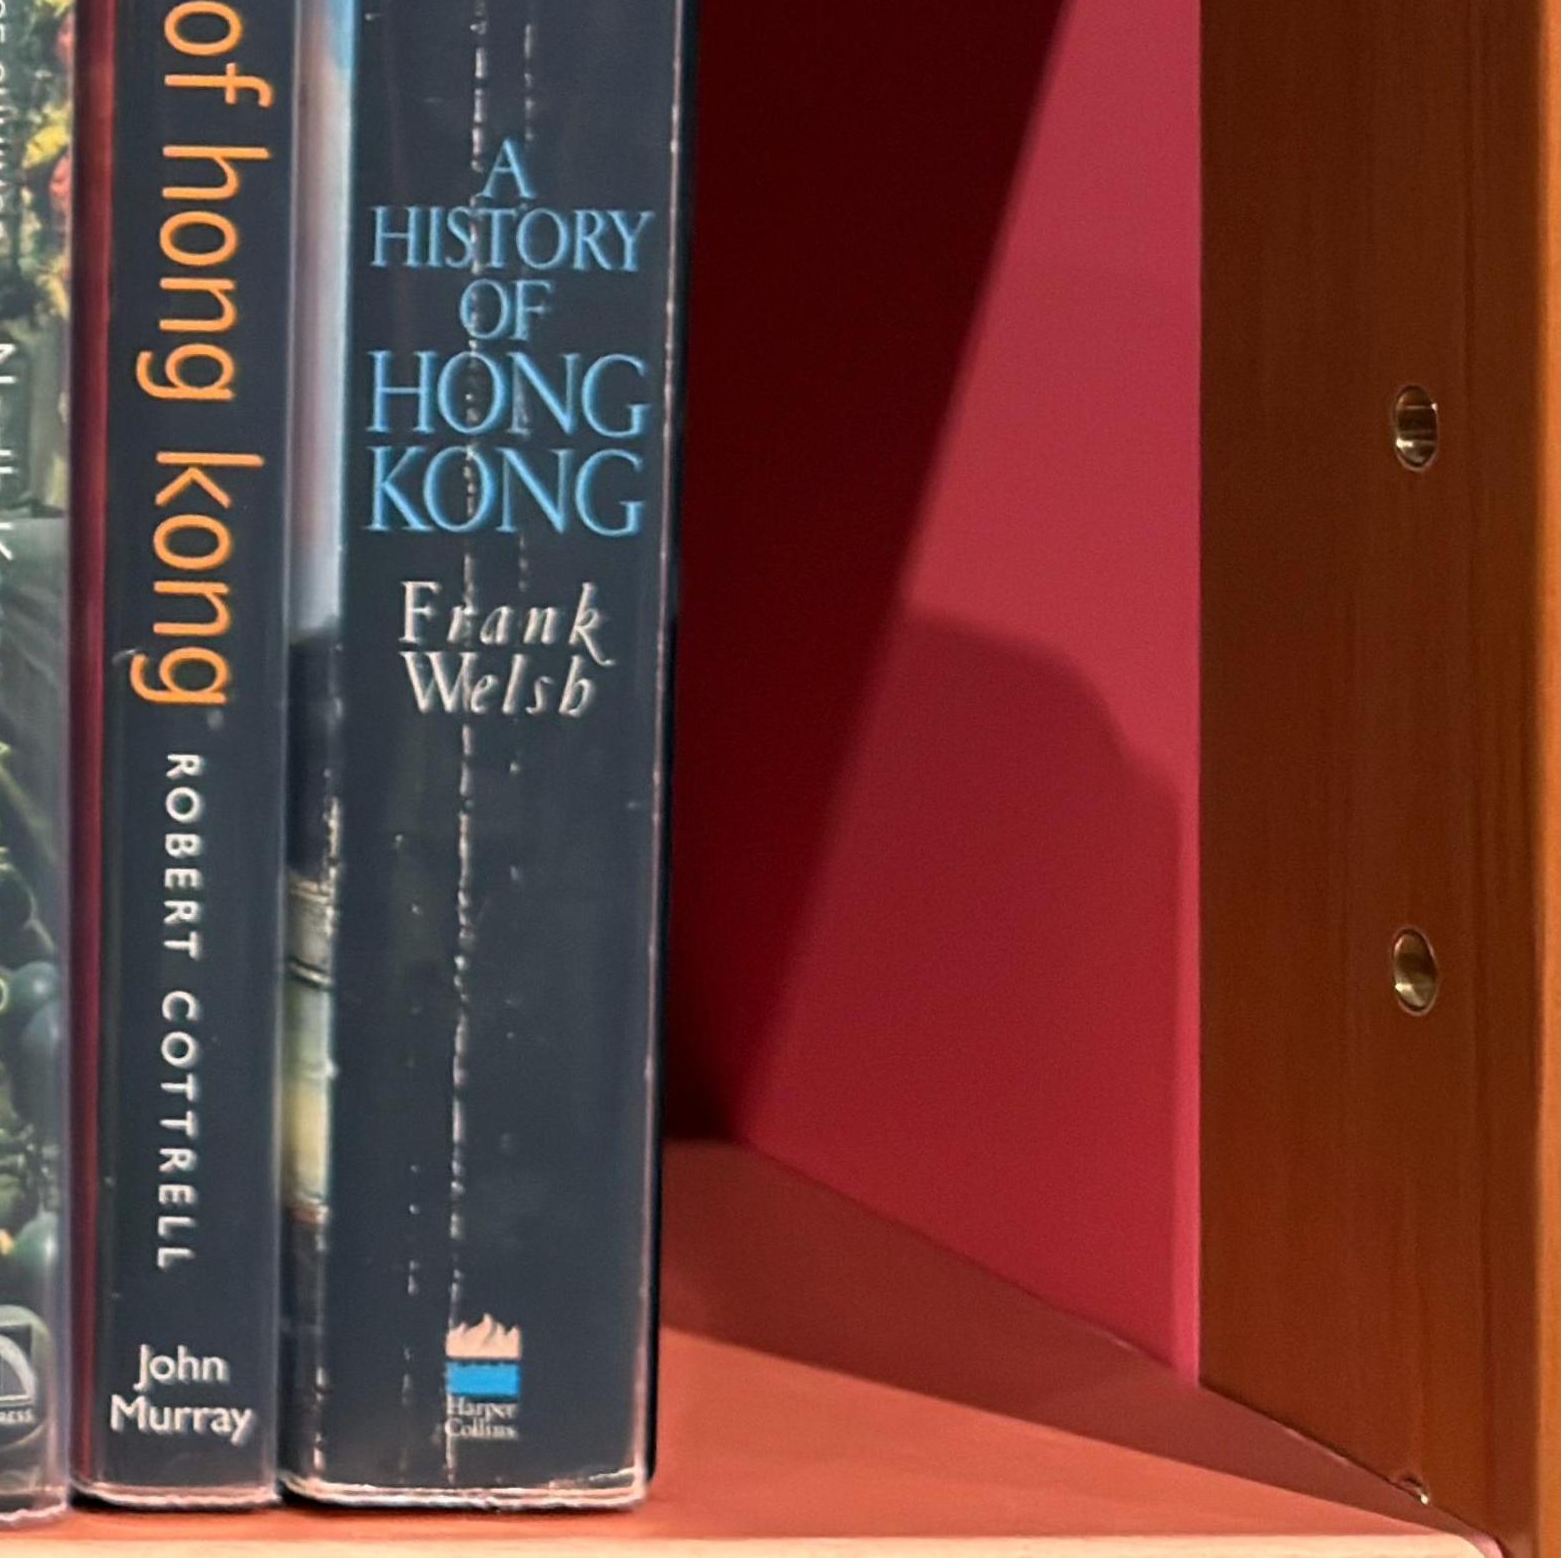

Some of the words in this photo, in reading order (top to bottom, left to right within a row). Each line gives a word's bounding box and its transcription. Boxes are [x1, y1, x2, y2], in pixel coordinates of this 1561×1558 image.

[164, 0, 273, 108] of
[135, 145, 272, 401] hong
[369, 205, 655, 273] HISTORY
[459, 277, 555, 342] OF
[365, 349, 655, 439] HONG
[365, 445, 646, 538] KONG
[129, 450, 266, 706] kong
[162, 753, 206, 961] ROBERT
[157, 990, 202, 1269] COTTRELL
[134, 1344, 229, 1391] John
[446, 1398, 516, 1419] Harper
[109, 1395, 254, 1444] Murray
[445, 1419, 516, 1439] Collins
